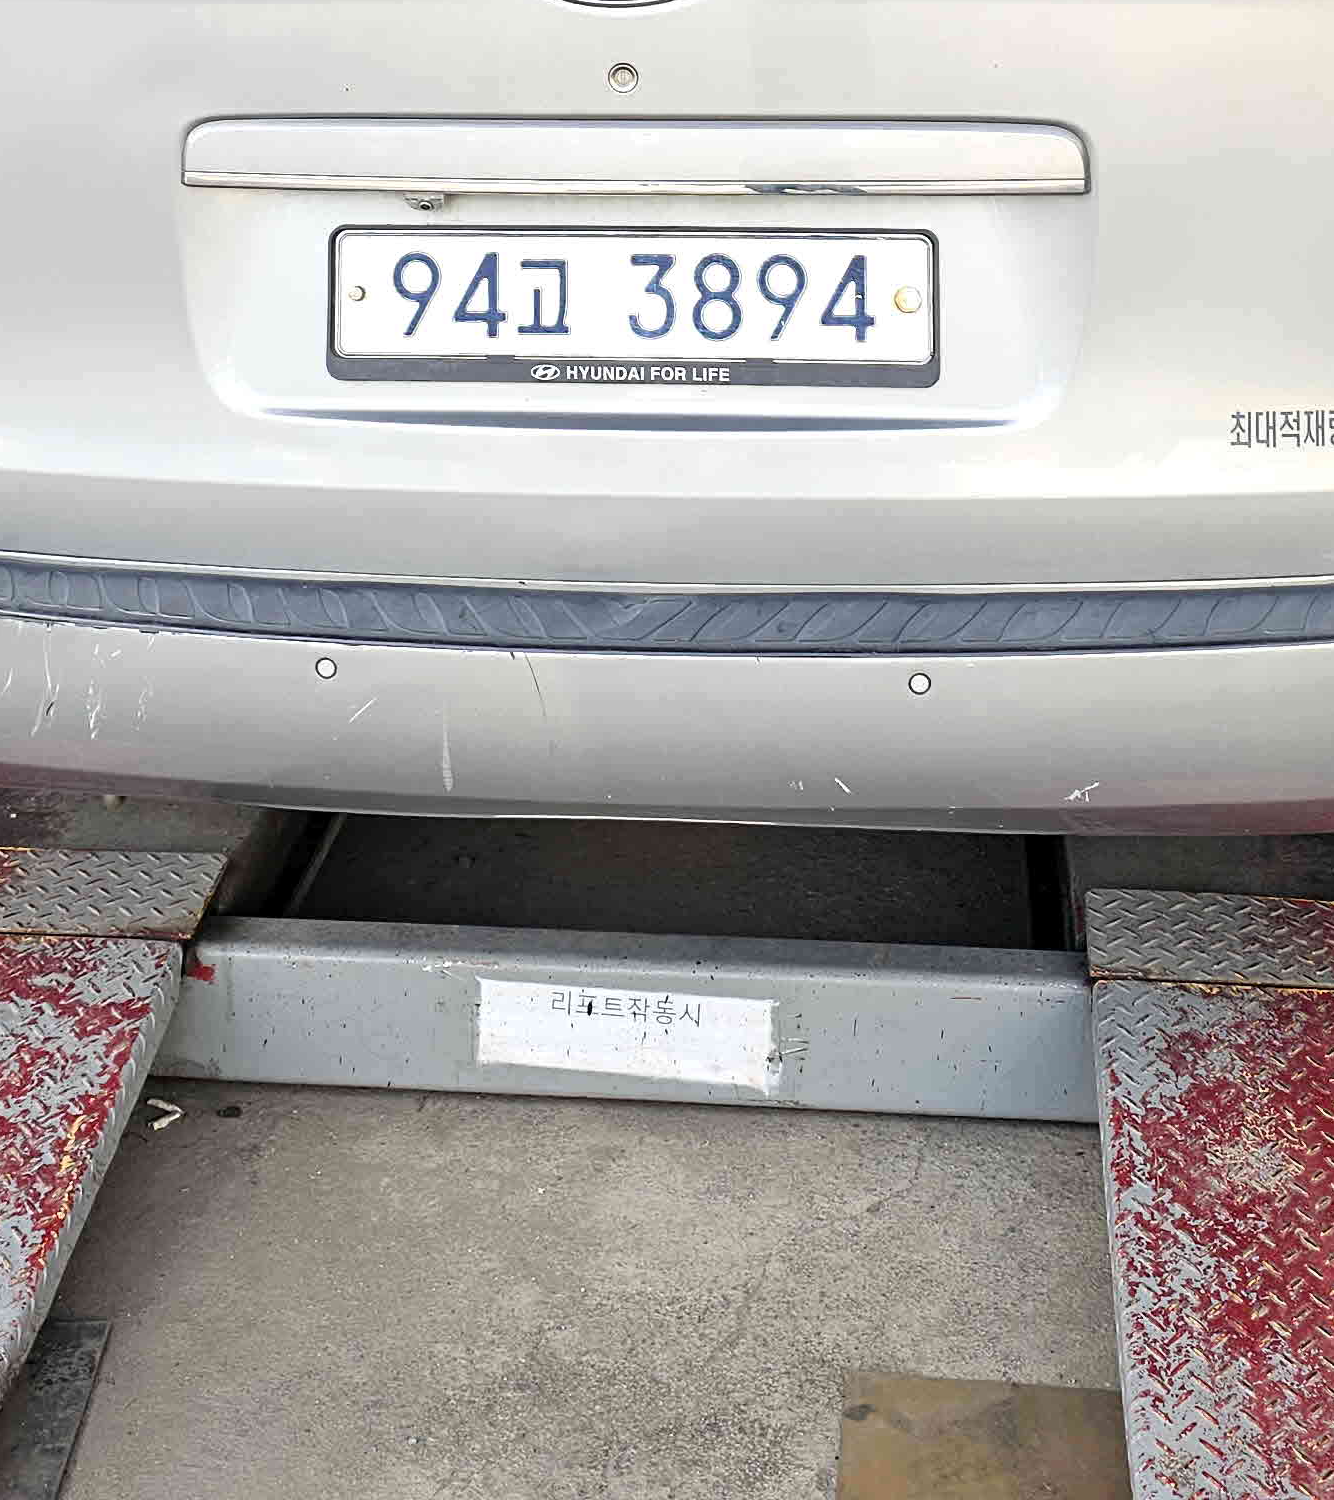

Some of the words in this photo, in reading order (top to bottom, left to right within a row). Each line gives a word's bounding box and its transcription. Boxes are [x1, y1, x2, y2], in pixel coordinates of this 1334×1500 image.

[392, 250, 572, 339] 94고
[628, 252, 876, 343] 3894
[566, 365, 645, 381] HYUNDAI
[651, 366, 687, 381] FOR
[692, 367, 731, 382] LIFE
